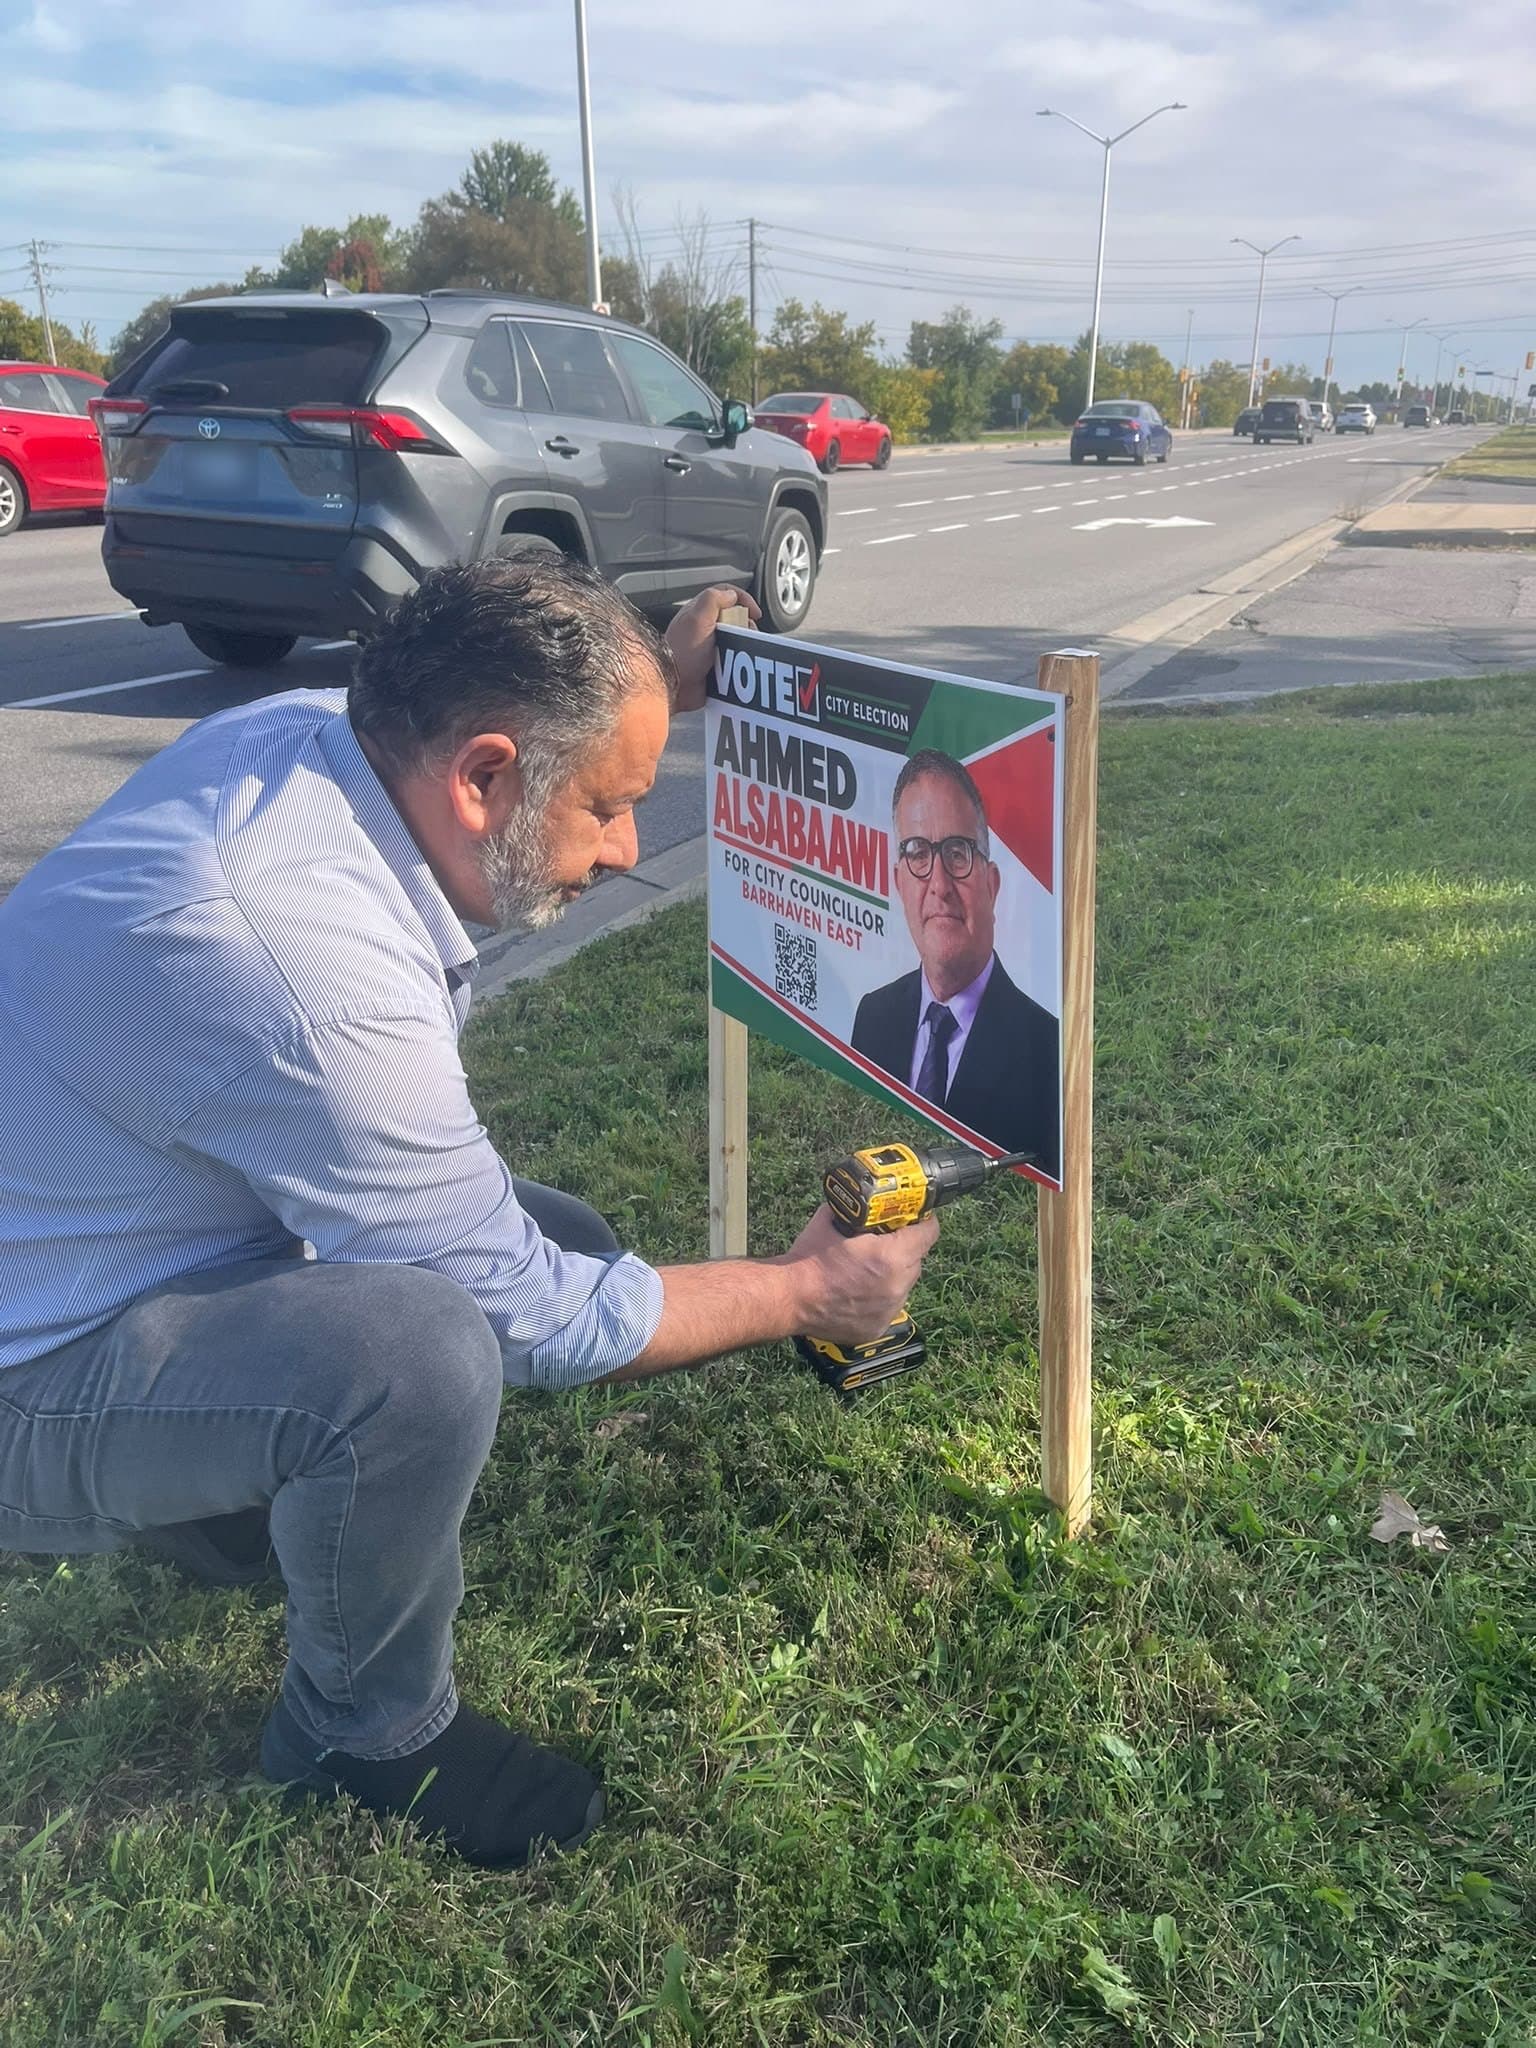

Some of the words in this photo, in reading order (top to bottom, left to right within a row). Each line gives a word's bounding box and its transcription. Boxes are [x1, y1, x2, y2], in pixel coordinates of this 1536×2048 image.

[714, 646, 796, 717] VOTE
[826, 695, 850, 715] CITY
[853, 702, 909, 732] ELECTION
[714, 715, 857, 811] AHMED
[713, 772, 889, 897] ALSABAAWI
[724, 849, 750, 877] FOR
[755, 863, 785, 892] CITY
[790, 878, 885, 936] COUNCILLOR
[742, 880, 822, 933] BARRHAVEN
[827, 918, 863, 951] EAST
